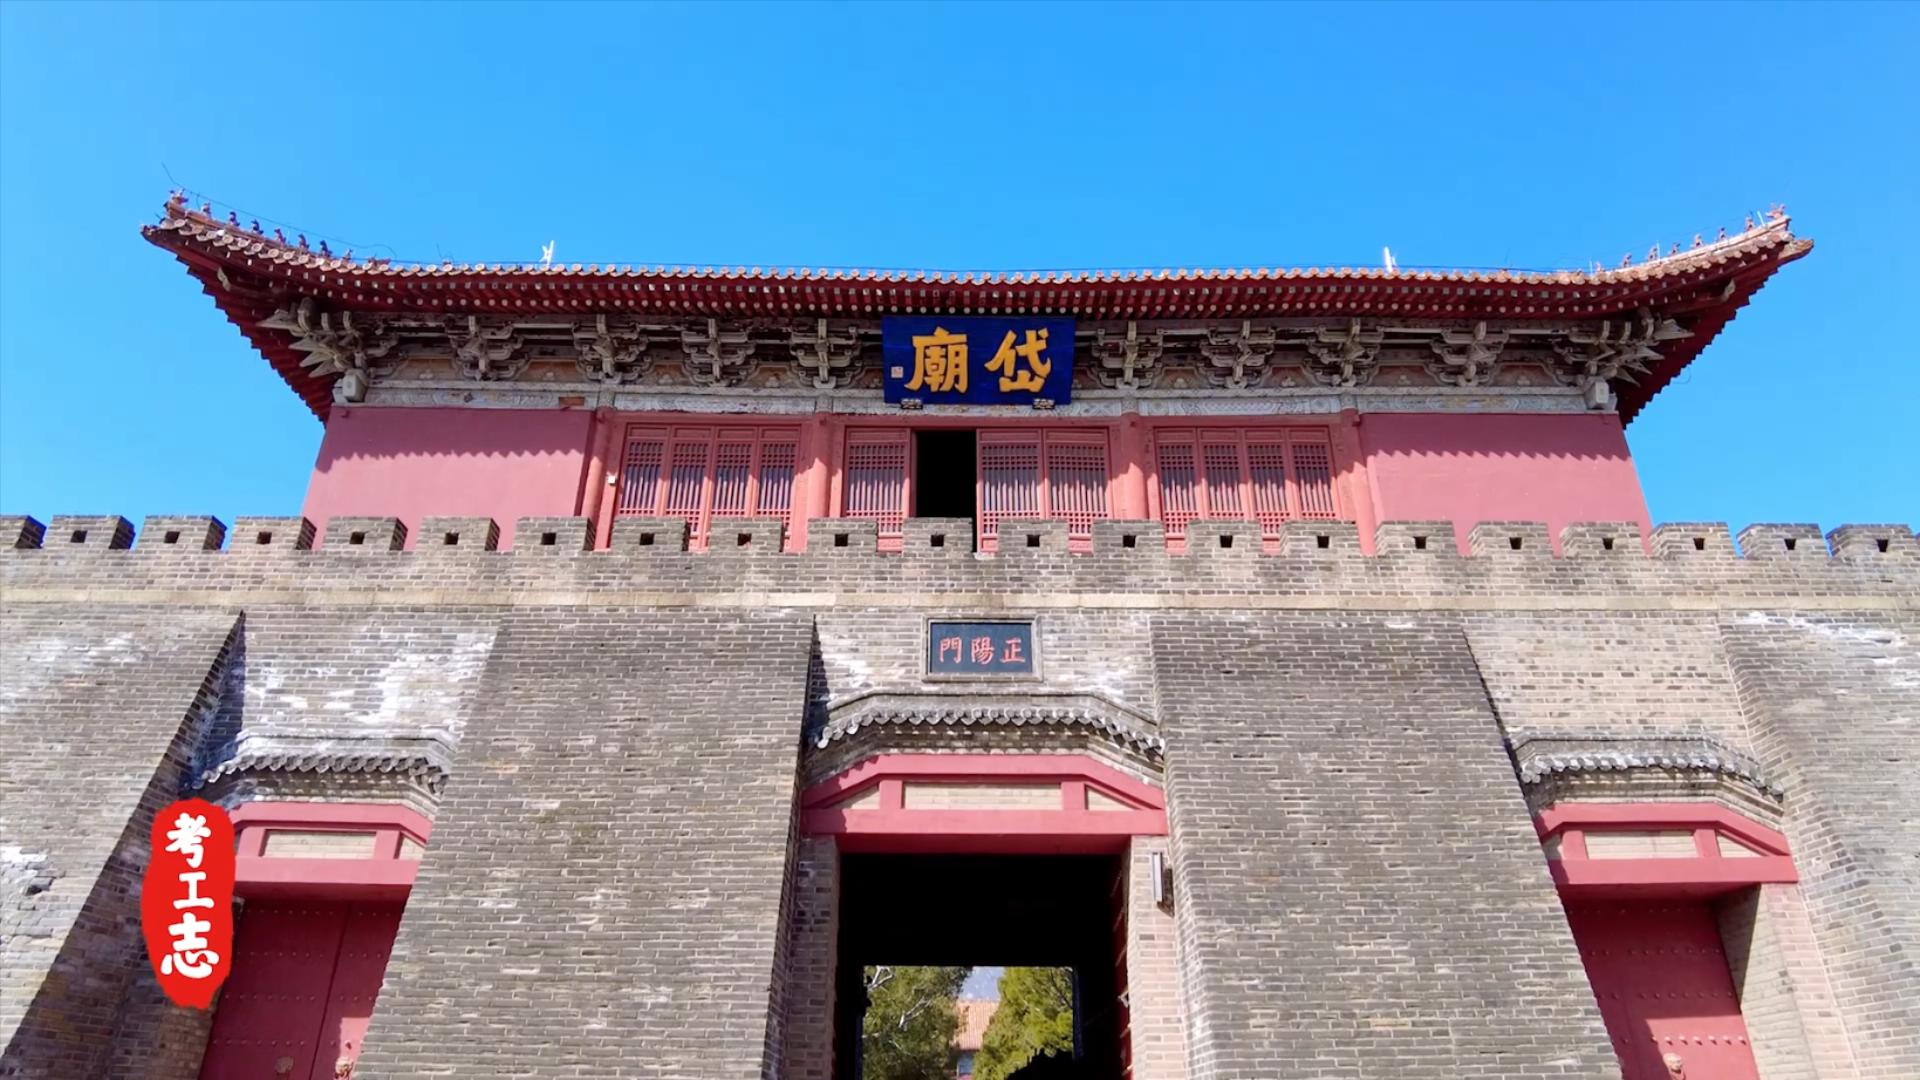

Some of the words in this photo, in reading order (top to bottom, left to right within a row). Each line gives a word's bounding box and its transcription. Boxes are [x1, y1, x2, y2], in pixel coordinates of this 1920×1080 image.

[904, 326, 1051, 393] 岱廟
[939, 636, 1026, 665] 正陽門
